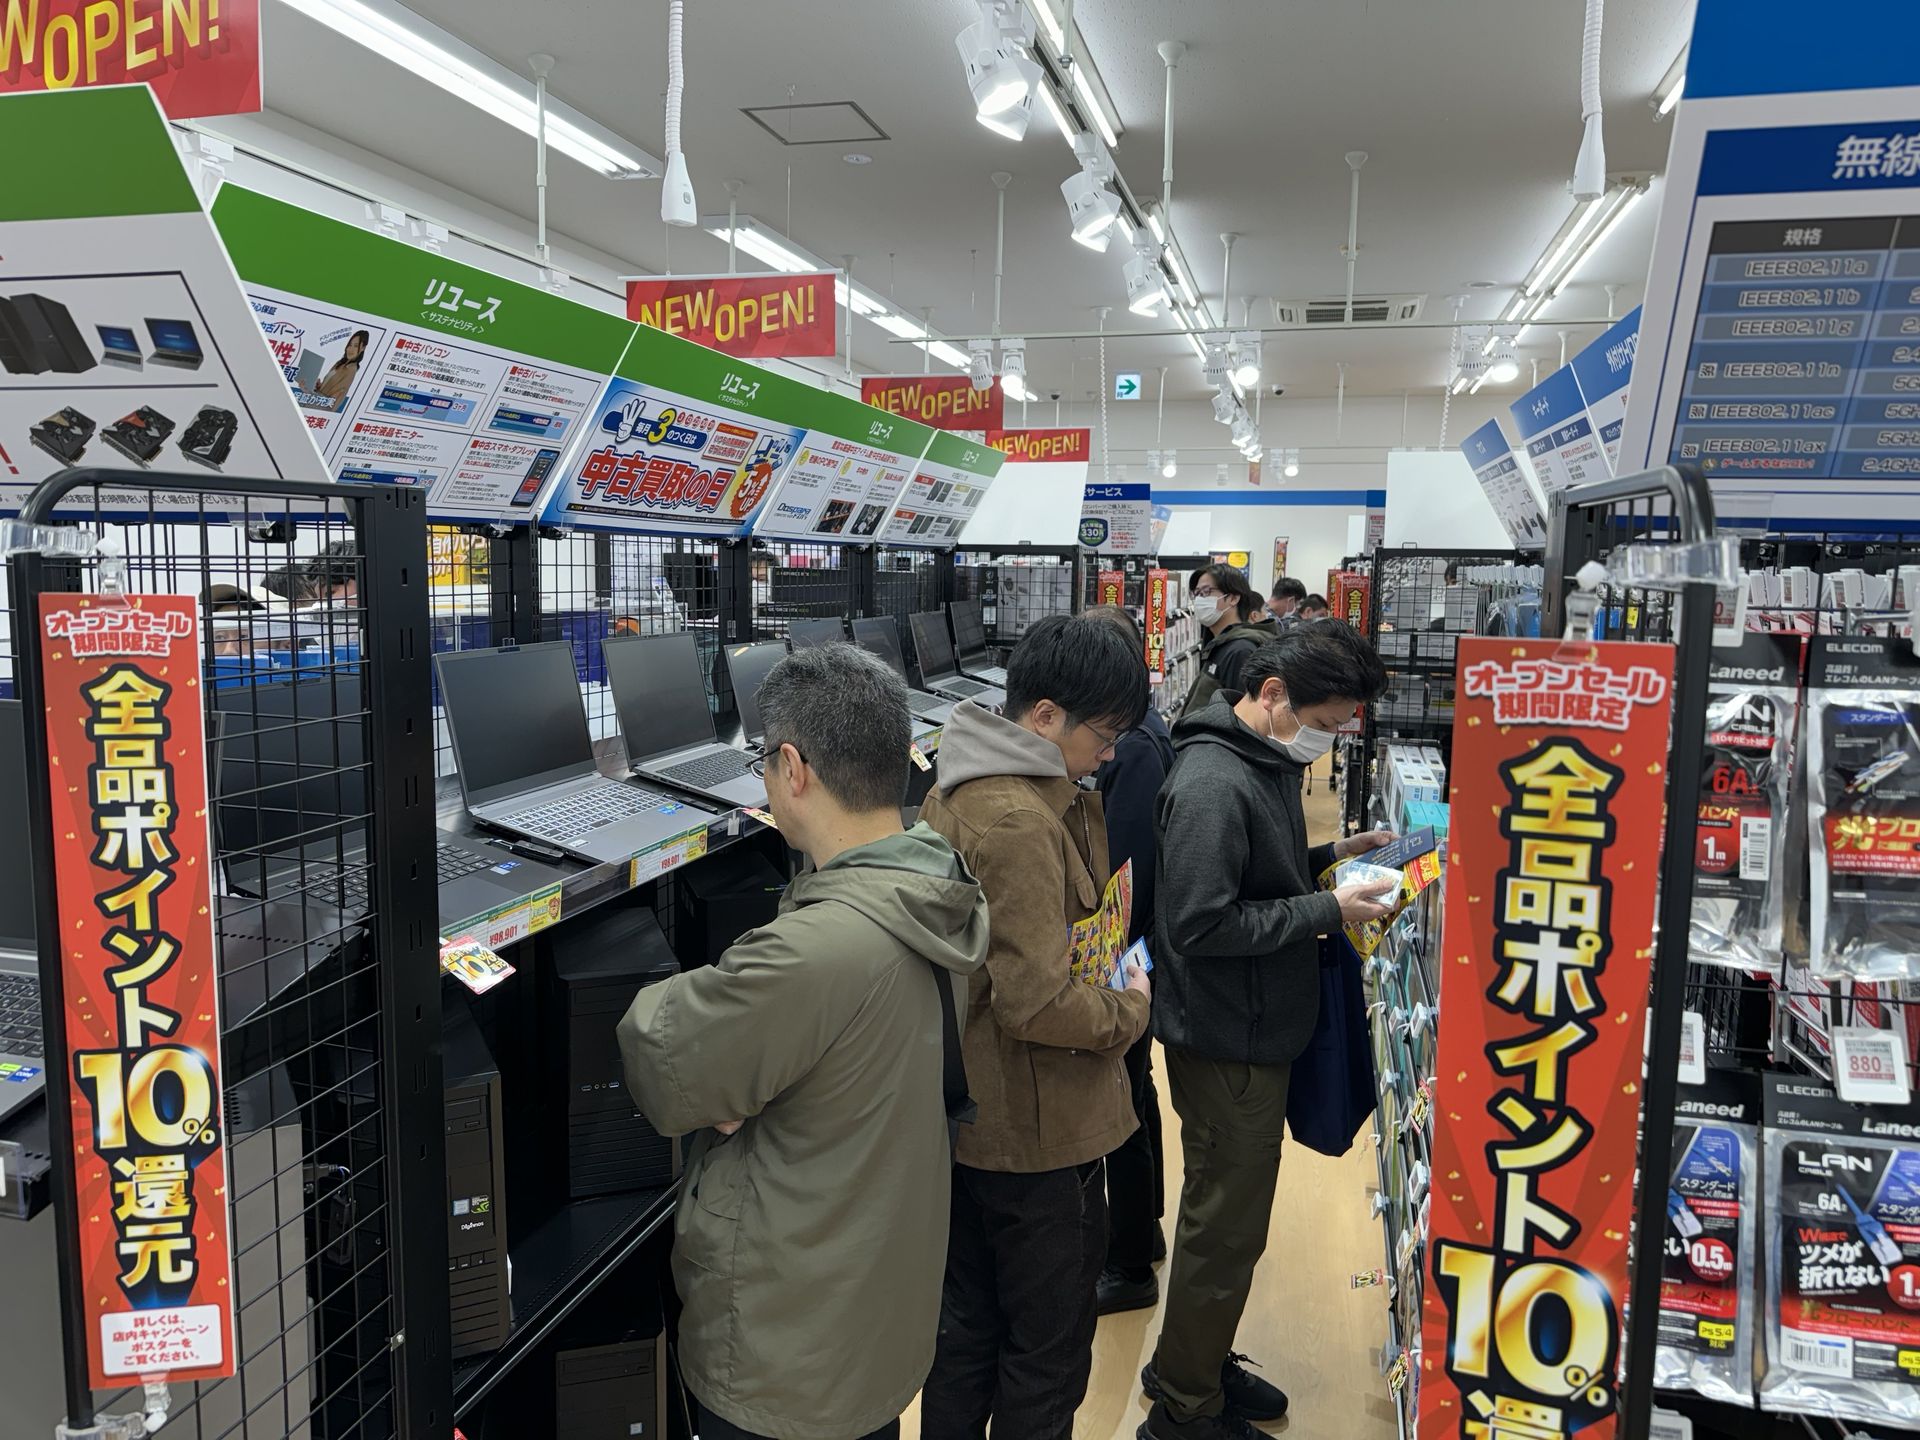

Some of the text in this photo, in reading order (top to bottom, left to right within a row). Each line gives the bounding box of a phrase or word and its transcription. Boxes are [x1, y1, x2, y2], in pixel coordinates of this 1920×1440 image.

[1783, 228, 1822, 246] 規格
[1745, 258, 1868, 277] IEEE802.11a
[422, 278, 502, 324] リユース
[1738, 288, 1861, 307] IEEE802.11b
[640, 284, 815, 342] NEW OPEN!
[1732, 318, 1853, 336] IEEE802.11g
[404, 341, 451, 359] 中古パソコン
[280, 364, 299, 383] 証
[517, 367, 548, 381] 中古パーツ
[1723, 362, 1841, 378] IEEE802.11n
[720, 372, 761, 401] リユース
[870, 383, 990, 420] NEW OPEN!
[1710, 404, 1835, 420] IEEE802.11ac
[304, 415, 330, 429] 充実!
[868, 420, 894, 439] リユース
[362, 424, 424, 440] 中古液晶モニター
[478, 441, 537, 456] 中古スマホ・タブレット
[992, 432, 1080, 460] NEW OPEN!
[1702, 439, 1826, 454] IEEE802.11ax
[579, 447, 735, 511] 中古買取の日
[45, 609, 192, 639] オープンセール
[71, 631, 172, 658] 期間限定
[1825, 643, 1884, 653] ELECOM
[1464, 660, 1666, 704] オープンセール
[1824, 674, 1920, 685] エレコムのLANケーブ
[1493, 691, 1631, 731] 期間限定
[1851, 711, 1897, 722] スタンダード
[1730, 723, 1769, 734] CABLE
[1712, 767, 1749, 795] 6A
[1703, 836, 1726, 861] 1m
[79, 670, 216, 1290] 全品ポイント10%還元
[1850, 1055, 1881, 1072] 880
[1776, 1084, 1834, 1098] ELECOM
[1675, 1100, 1745, 1119] aneed
[1798, 1150, 1873, 1173] LAN
[1798, 1166, 1834, 1177] CABLE
[1680, 1177, 1736, 1191] スタンダード
[1818, 1192, 1842, 1212] 6A
[1691, 1243, 1733, 1271] 0.5m
[1799, 1240, 1864, 1265] ツメが
[1799, 1265, 1890, 1289] 折れない
[134, 1314, 185, 1328] 詳しくは、
[112, 1325, 209, 1342] 店内キャンペーン
[131, 1338, 192, 1353] ポスターを
[1709, 1339, 1727, 1349] 対応
[123, 1350, 200, 1366] ご覧ください。
